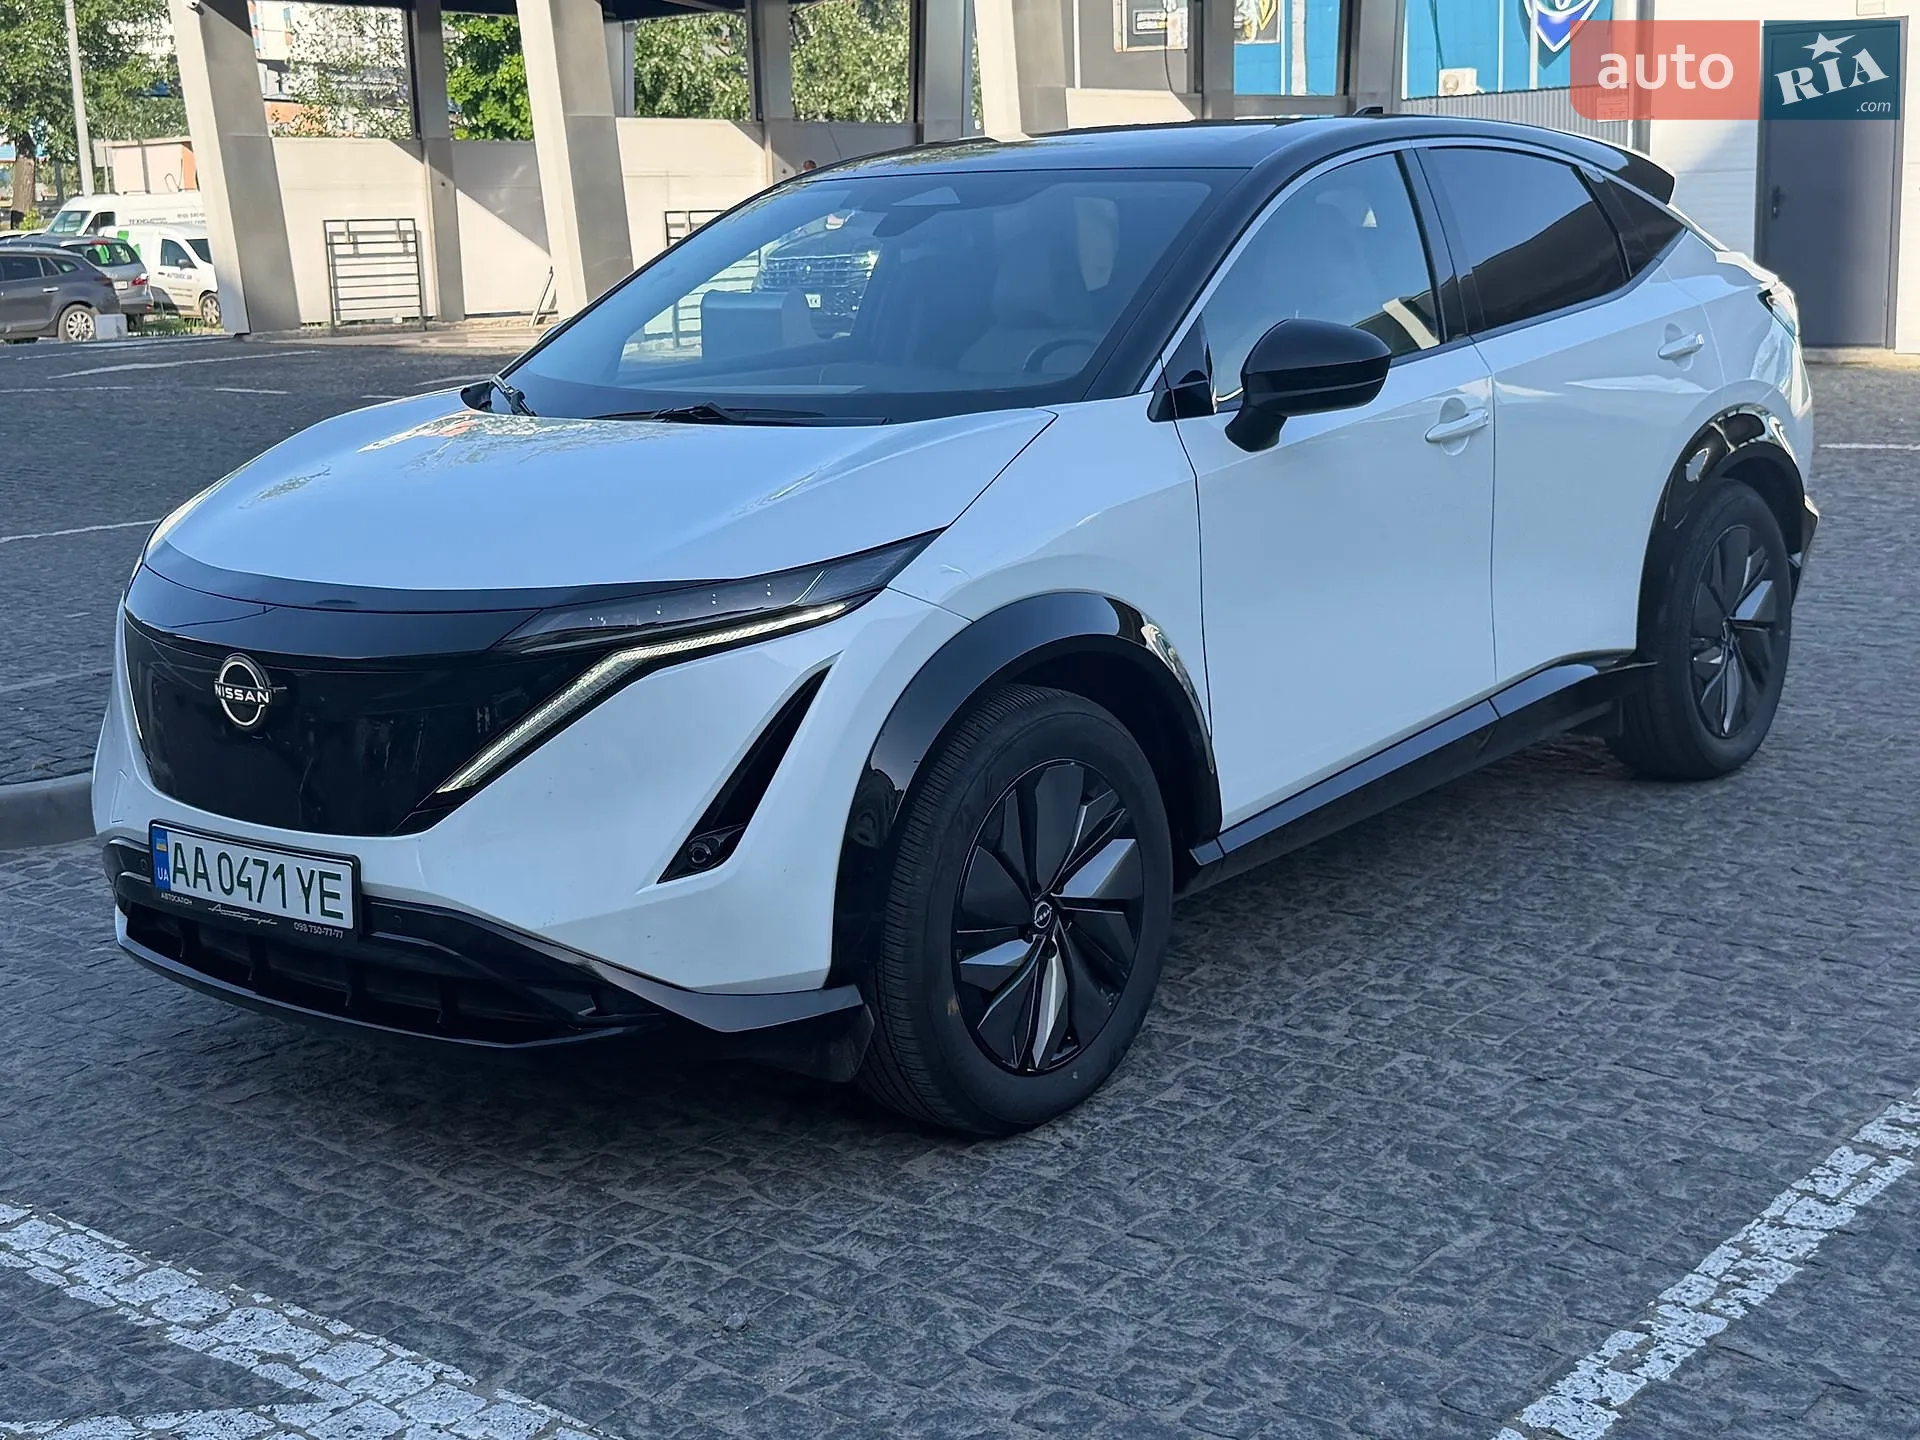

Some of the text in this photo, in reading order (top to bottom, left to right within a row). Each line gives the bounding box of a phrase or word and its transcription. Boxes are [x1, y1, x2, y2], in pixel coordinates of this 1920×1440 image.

[214, 683, 270, 703] NISSAN
[157, 866, 170, 881] UA
[172, 842, 344, 920] AA 0471 YE
